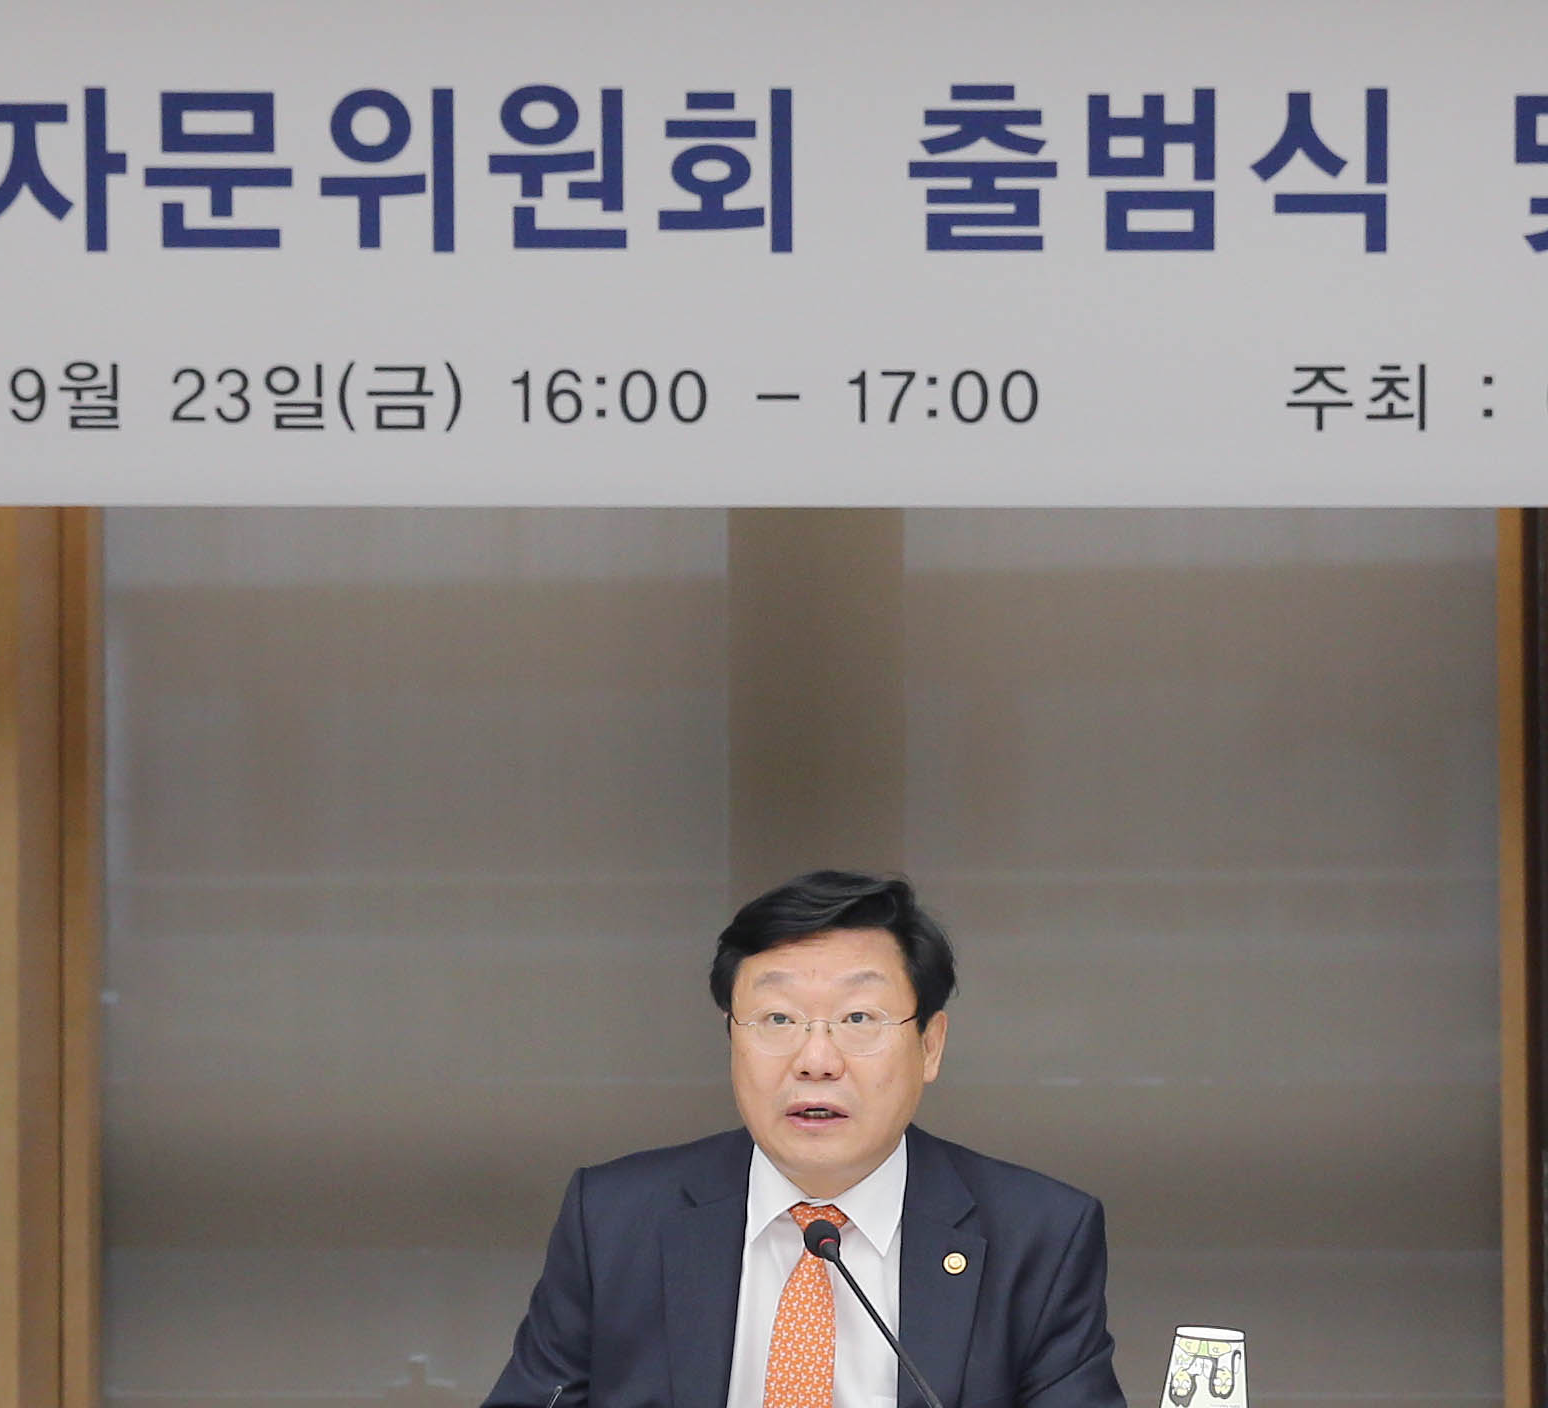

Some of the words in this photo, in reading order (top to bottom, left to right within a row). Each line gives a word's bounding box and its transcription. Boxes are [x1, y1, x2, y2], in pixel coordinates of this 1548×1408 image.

[908, 85, 1389, 253] 출범식
[9, 361, 120, 430] 9월
[170, 361, 462, 432] 23일(금)
[512, 368, 708, 424] 16:00
[848, 368, 1039, 424] 17:00
[1286, 363, 1427, 432] 주최
